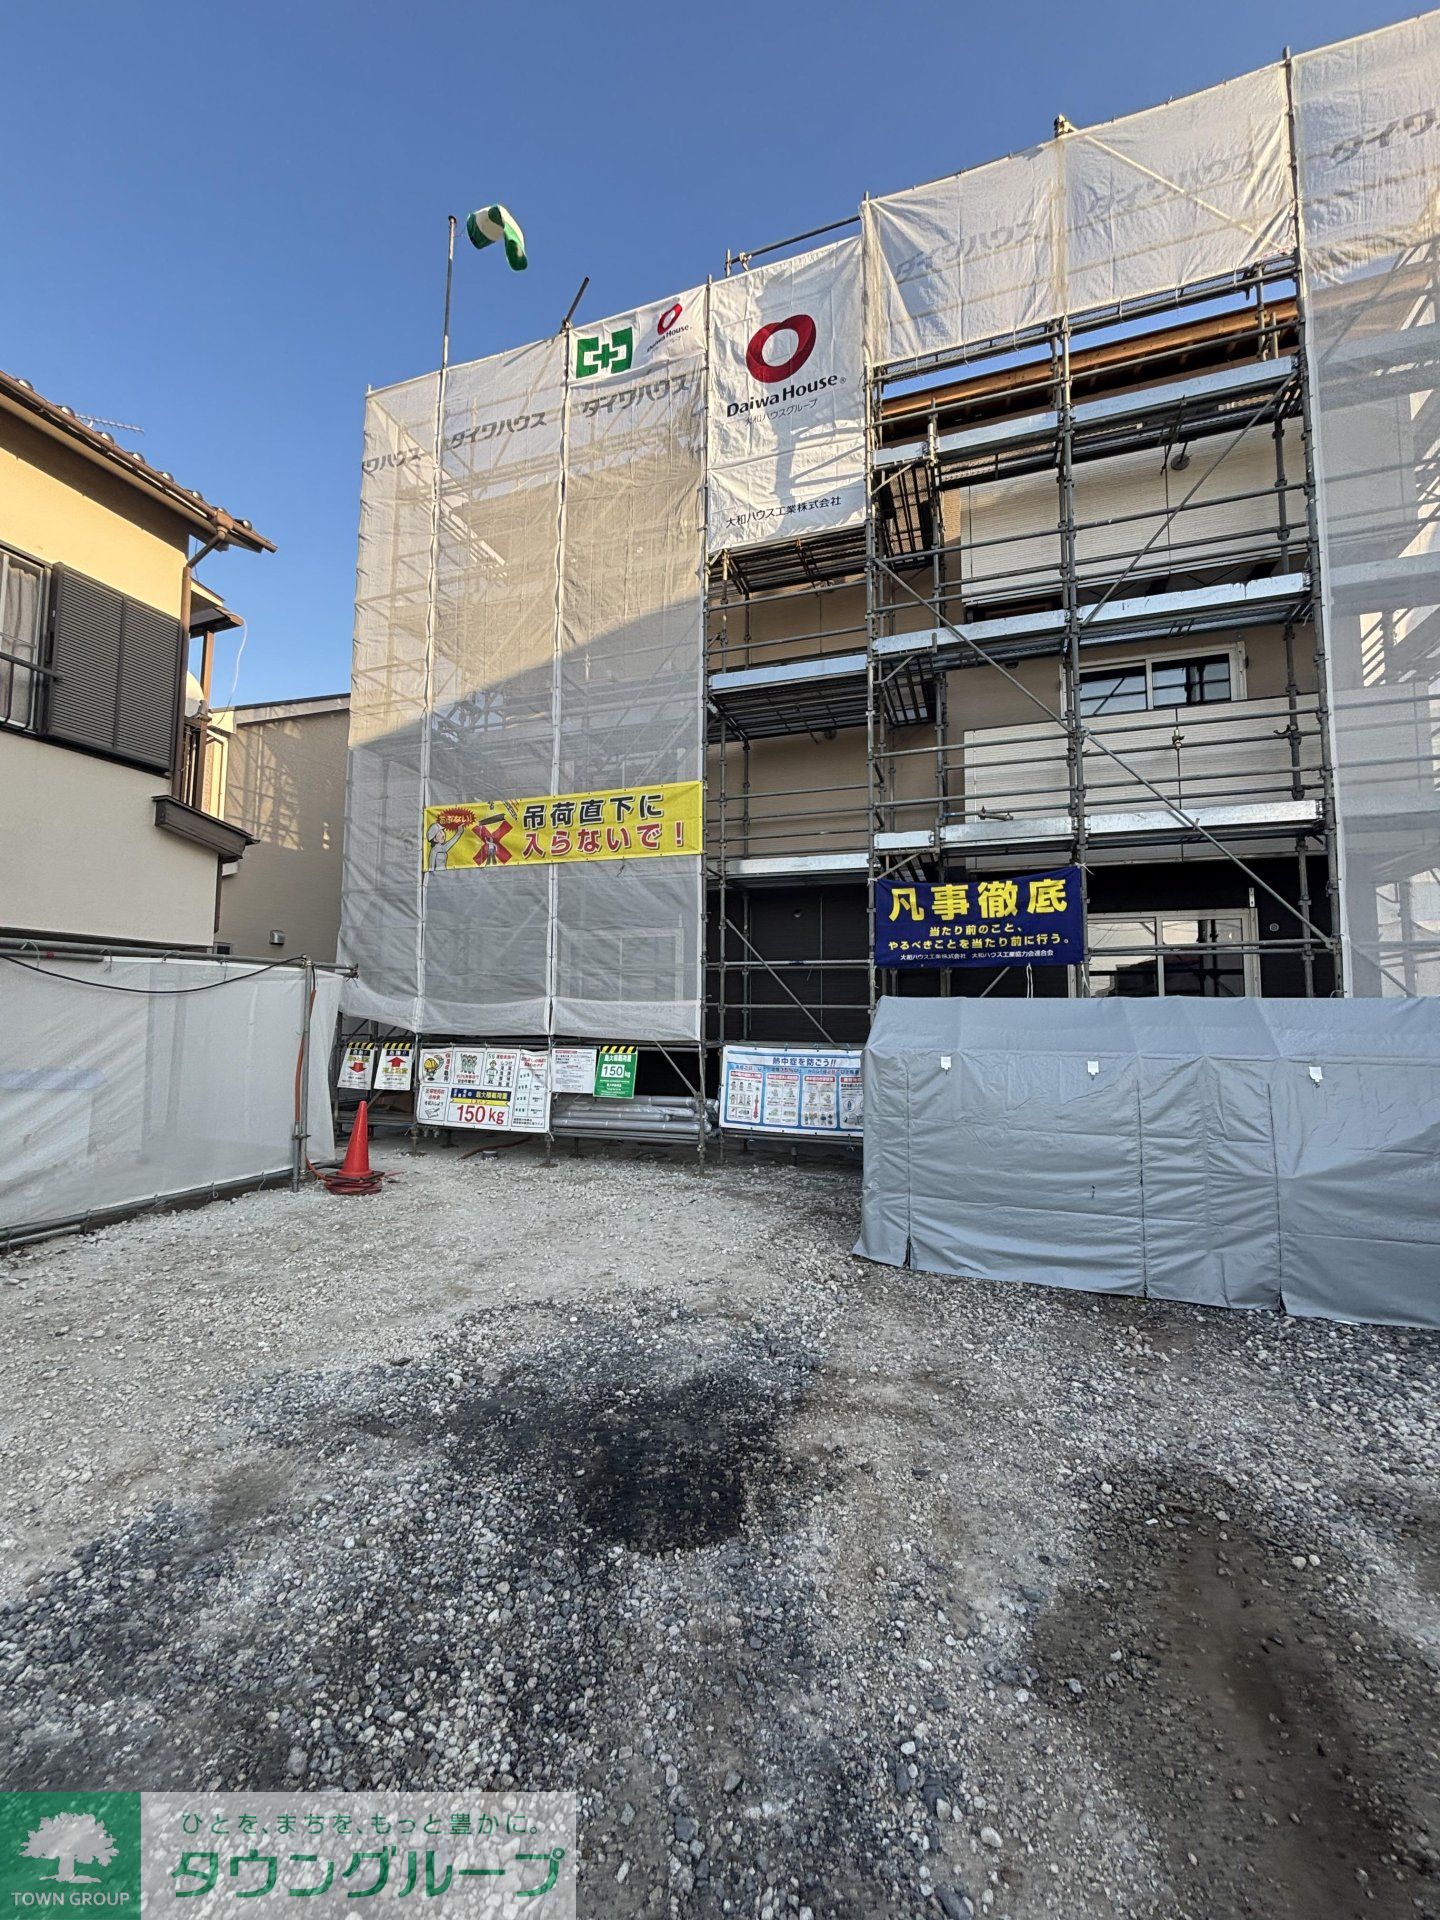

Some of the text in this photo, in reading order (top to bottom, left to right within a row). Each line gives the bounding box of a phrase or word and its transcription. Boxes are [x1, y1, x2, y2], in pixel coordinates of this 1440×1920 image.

[1329, 108, 1440, 166] ダイワ
[582, 374, 690, 418] ダイワハウス
[726, 374, 838, 418] Daiwa House
[744, 398, 819, 426] 大和ハウスグループ
[450, 411, 547, 450] ダイワハウス
[726, 495, 842, 529] 大和ハウス工業株式会社
[522, 793, 664, 829] 吊荷直下に
[888, 877, 1068, 922] 凡事徹底
[888, 933, 1069, 951] やるべきことを当たり前に行う。
[929, 923, 1023, 937] 当たり前のこと、
[900, 953, 967, 961] 大和ハウス工業株式会社
[603, 1065, 623, 1077] 150
[457, 1104, 486, 1123] 150
[488, 1107, 506, 1125] kg
